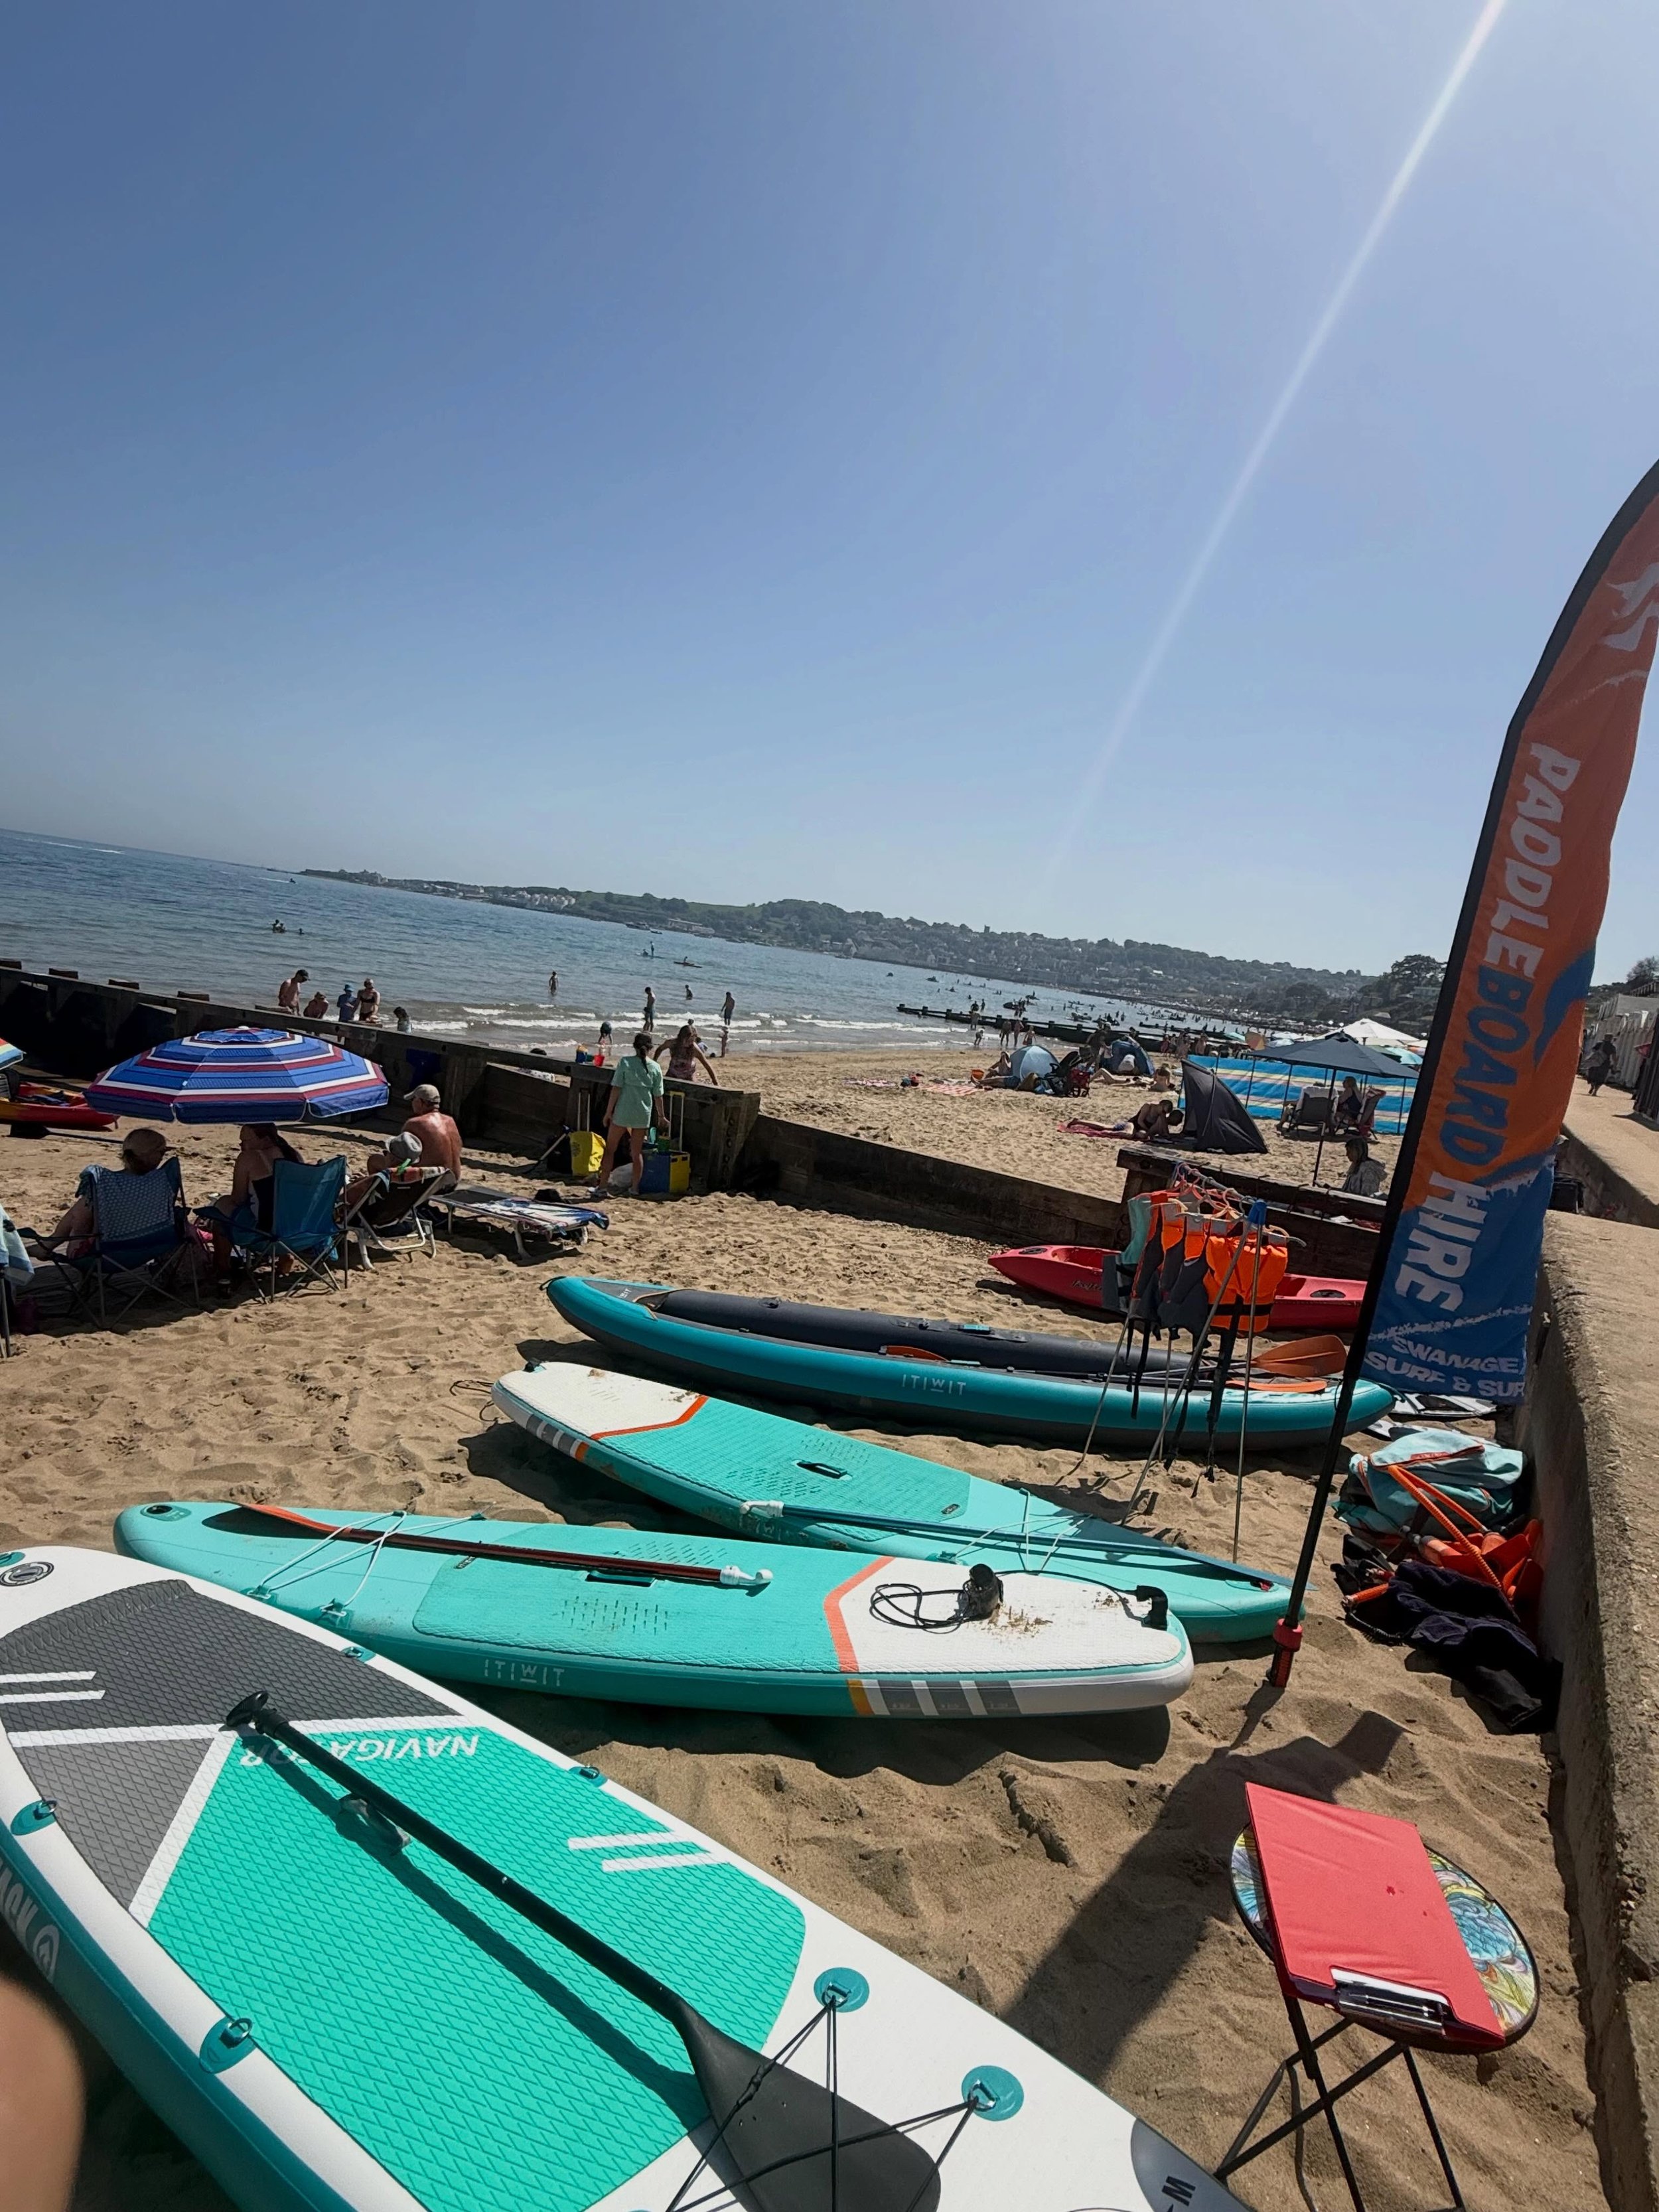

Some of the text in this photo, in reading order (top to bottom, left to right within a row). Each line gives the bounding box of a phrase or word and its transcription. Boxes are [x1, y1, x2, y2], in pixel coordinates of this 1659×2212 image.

[1395, 1170, 1491, 1313] HIRE
[1392, 1331, 1521, 1374] SWANAGE
[902, 1374, 967, 1396] ITIWIT
[1364, 1351, 1447, 1383] SURF
[1451, 1375, 1472, 1392] &
[484, 1659, 565, 1687] ITIWIT
[239, 1734, 480, 1768] NAVIGAOR
